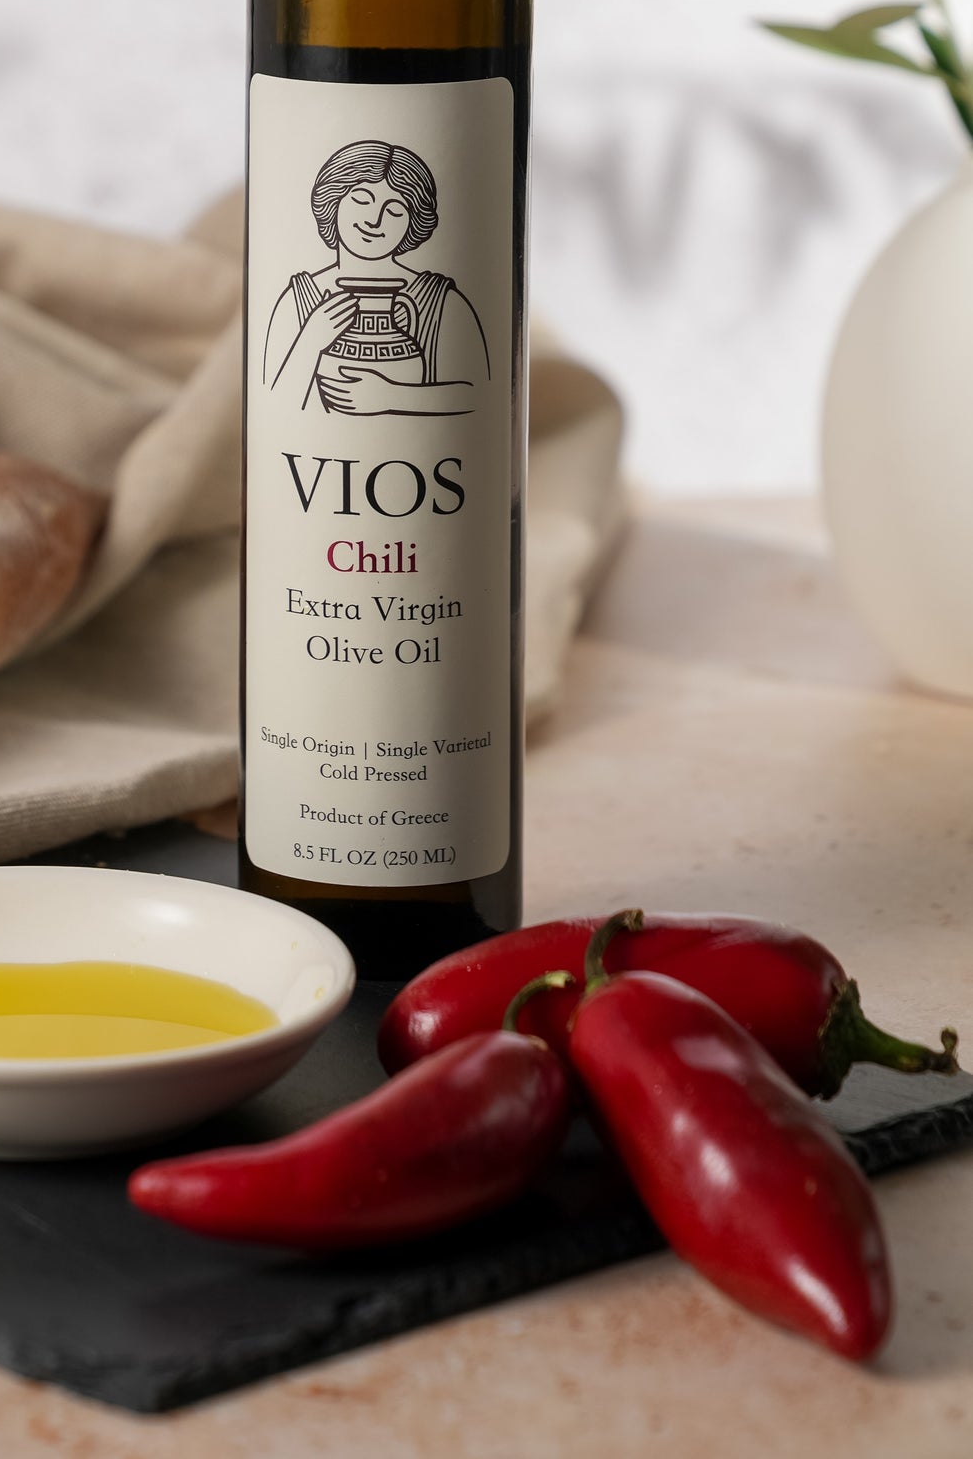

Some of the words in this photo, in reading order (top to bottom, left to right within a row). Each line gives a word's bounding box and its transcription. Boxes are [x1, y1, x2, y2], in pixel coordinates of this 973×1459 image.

[281, 452, 465, 517] VIOS
[327, 540, 419, 573] Chili
[285, 587, 362, 620] Extra
[371, 595, 464, 625] Virgin
[306, 635, 384, 664] Olive
[394, 637, 441, 664] Oil
[261, 726, 298, 750] Single
[302, 736, 355, 757] Origin
[376, 742, 428, 759] Single
[432, 731, 492, 756] Varietal
[319, 763, 358, 781] Cold
[364, 765, 427, 782] Pressed
[299, 803, 364, 825] Product
[368, 810, 388, 826] of
[391, 810, 450, 826] Greece
[293, 842, 314, 860] 8.5
[319, 846, 342, 864] FL
[347, 850, 377, 866] OZ
[382, 850, 418, 869] (250
[422, 846, 456, 865] ML)
